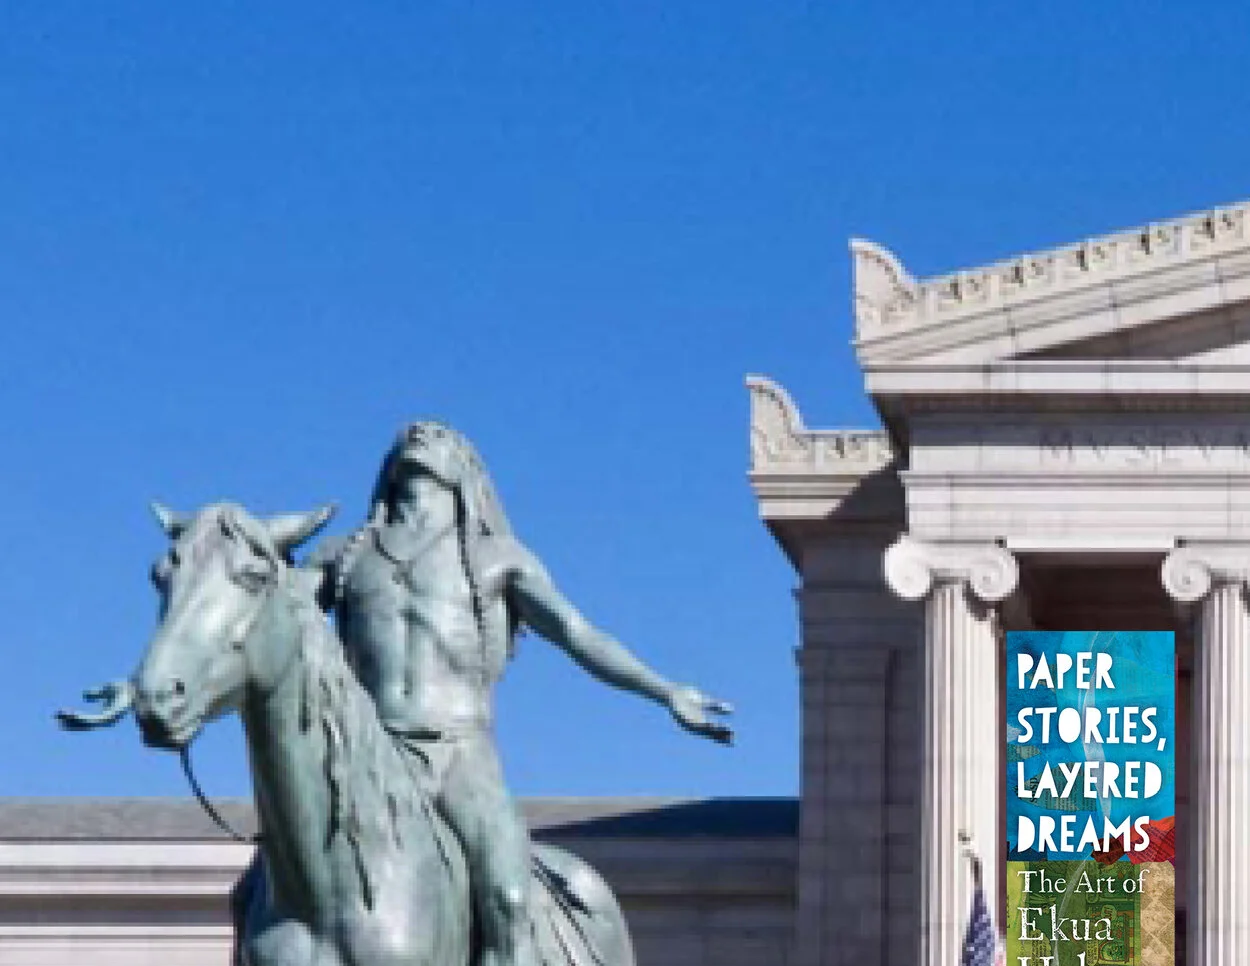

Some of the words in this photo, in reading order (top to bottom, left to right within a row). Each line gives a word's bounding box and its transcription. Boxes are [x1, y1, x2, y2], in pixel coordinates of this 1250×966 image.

[1018, 652, 1114, 689] PAPER
[1018, 707, 1165, 750] STORIES,
[1018, 762, 1161, 798] LAYERED
[1018, 816, 1149, 852] DREAMS
[1018, 869, 1066, 892] The
[1074, 871, 1115, 892] Art
[1123, 870, 1149, 892] of
[1018, 905, 1112, 940] Ekua
